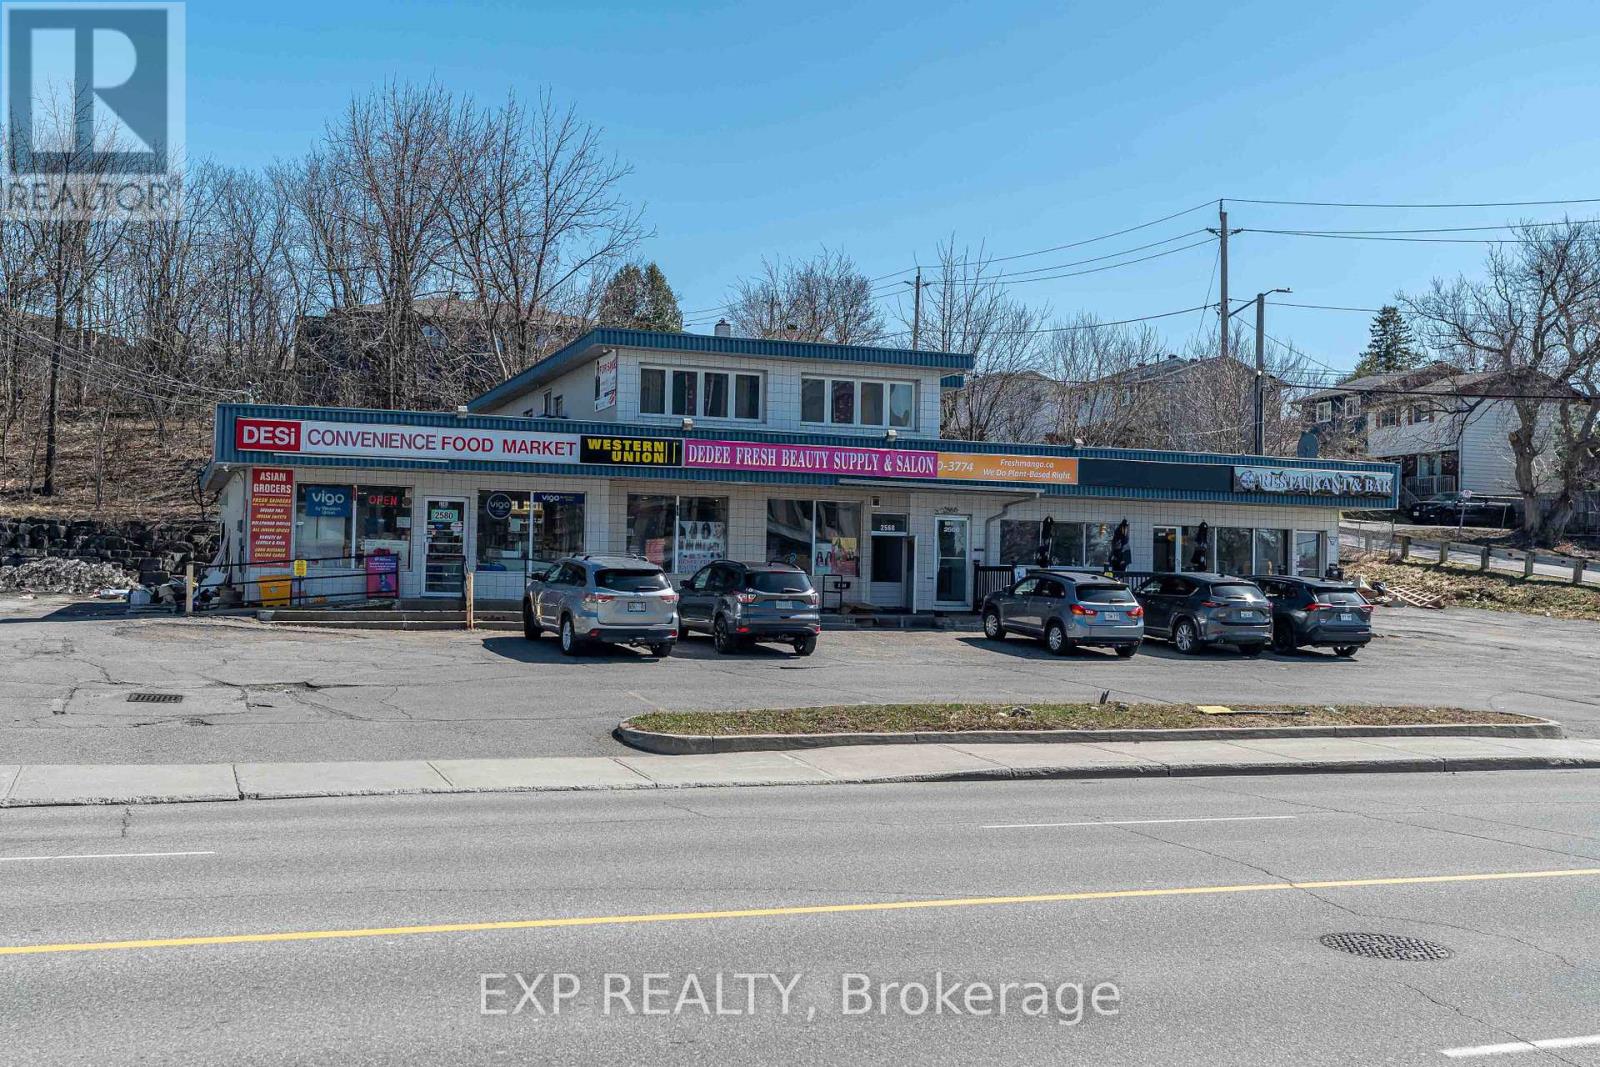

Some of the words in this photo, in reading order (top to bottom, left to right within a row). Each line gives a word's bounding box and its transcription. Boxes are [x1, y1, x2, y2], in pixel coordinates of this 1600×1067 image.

[242, 426, 296, 446] DESi
[307, 429, 437, 450] CONVENIENCE
[441, 436, 494, 452] FOOD
[502, 439, 577, 457] MARKET
[587, 438, 665, 453] WESTERN
[611, 450, 665, 464] UNION
[688, 444, 731, 465] DEDEE
[735, 447, 777, 467] FRESH
[781, 449, 830, 469] BEAUTY
[833, 451, 880, 472] SUPPLY
[883, 454, 893, 472] &
[896, 455, 935, 474] SALON
[260, 472, 286, 481] ASIAN
[983, 468, 994, 476] We
[996, 469, 1007, 477] Do
[1007, 470, 1051, 479] Plant-Based
[1051, 471, 1071, 480] Right
[253, 483, 292, 493] GROCERS
[1259, 471, 1350, 493] RESTAURANT
[1352, 478, 1362, 492] &
[1365, 478, 1392, 493] BAR
[312, 490, 345, 505] vigo
[368, 495, 398, 506] OPEN
[435, 511, 453, 519] 2580
